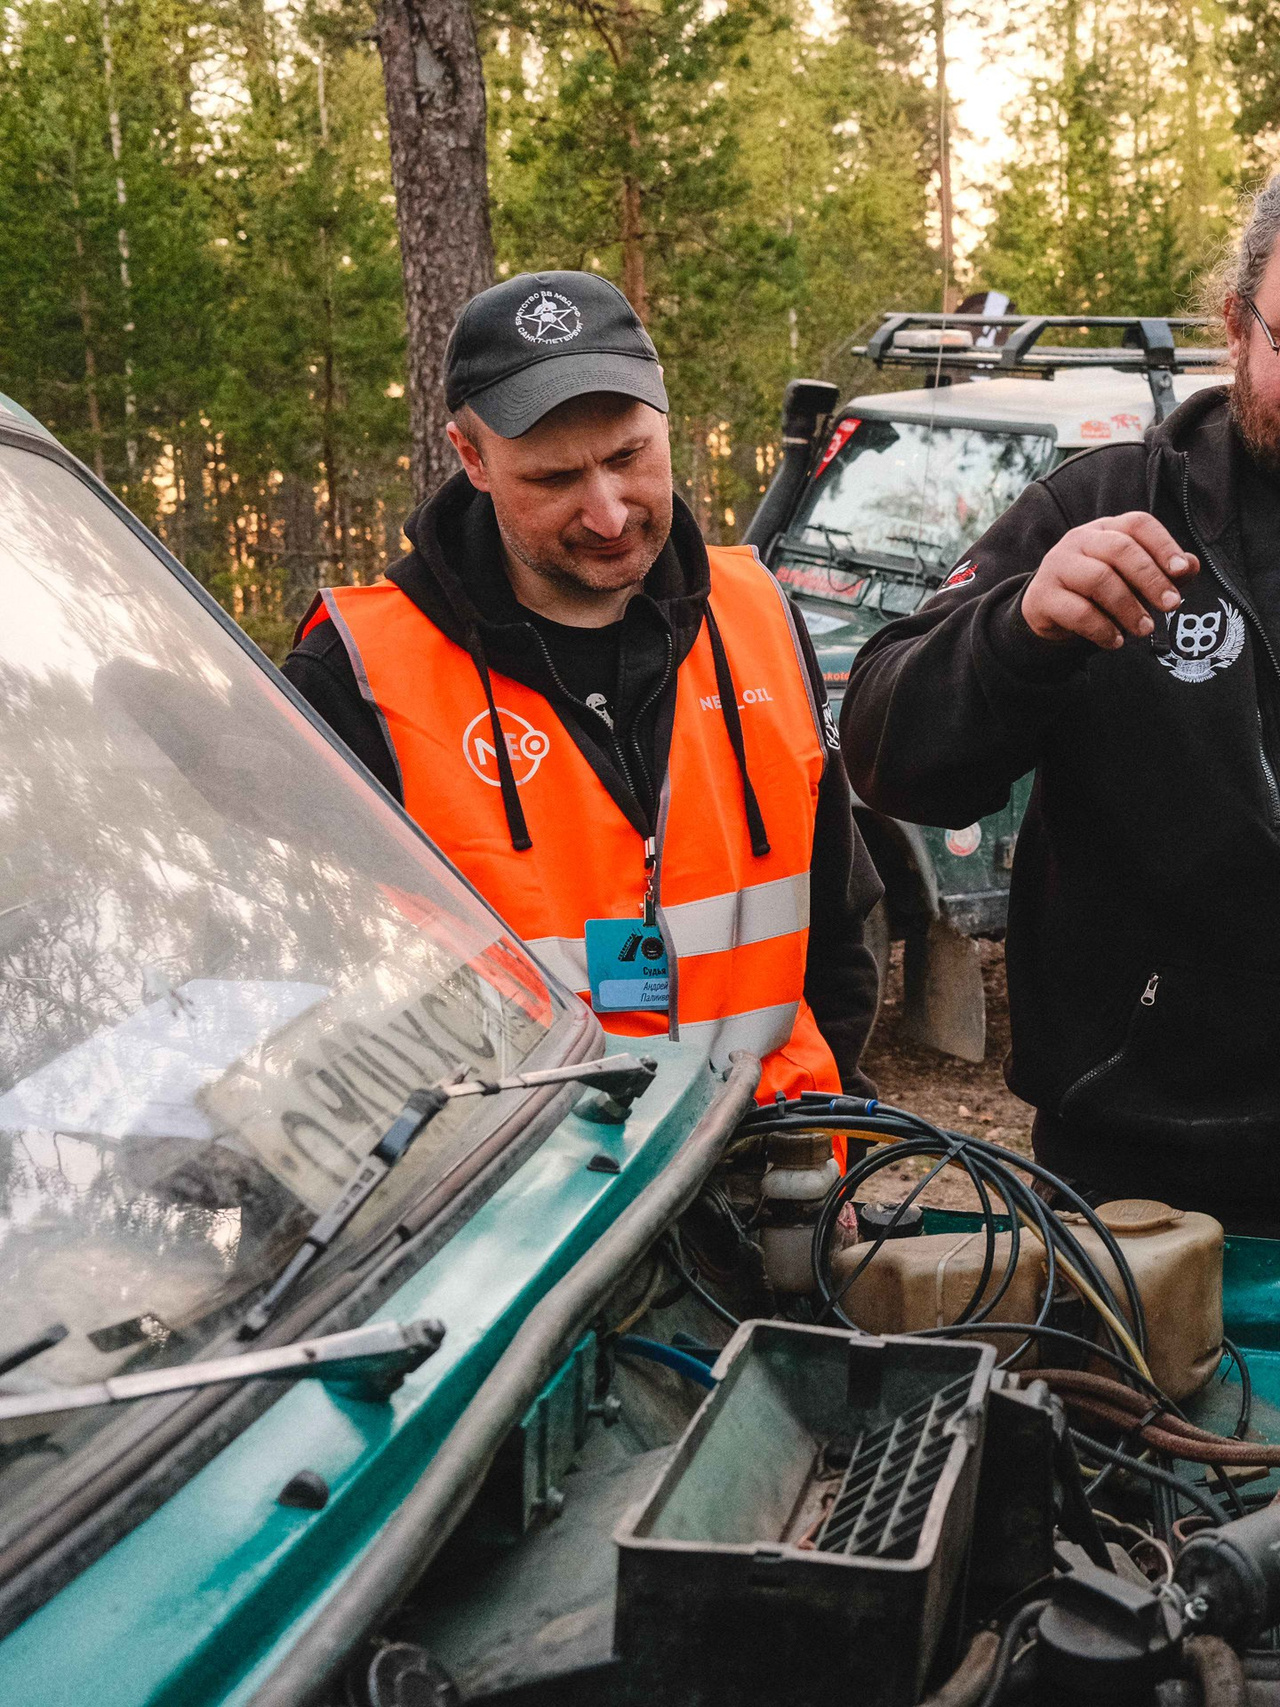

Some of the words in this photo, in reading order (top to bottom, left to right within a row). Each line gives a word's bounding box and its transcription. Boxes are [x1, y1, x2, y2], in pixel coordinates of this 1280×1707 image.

[515, 292, 540, 326] БРАТСТВО
[554, 292, 573, 307] МВД
[570, 305, 582, 318] РФ
[517, 319, 584, 345] САНКТ-ПЕТЕРБУРГ
[642, 966, 667, 977] Судья
[642, 981, 669, 992] Андрей
